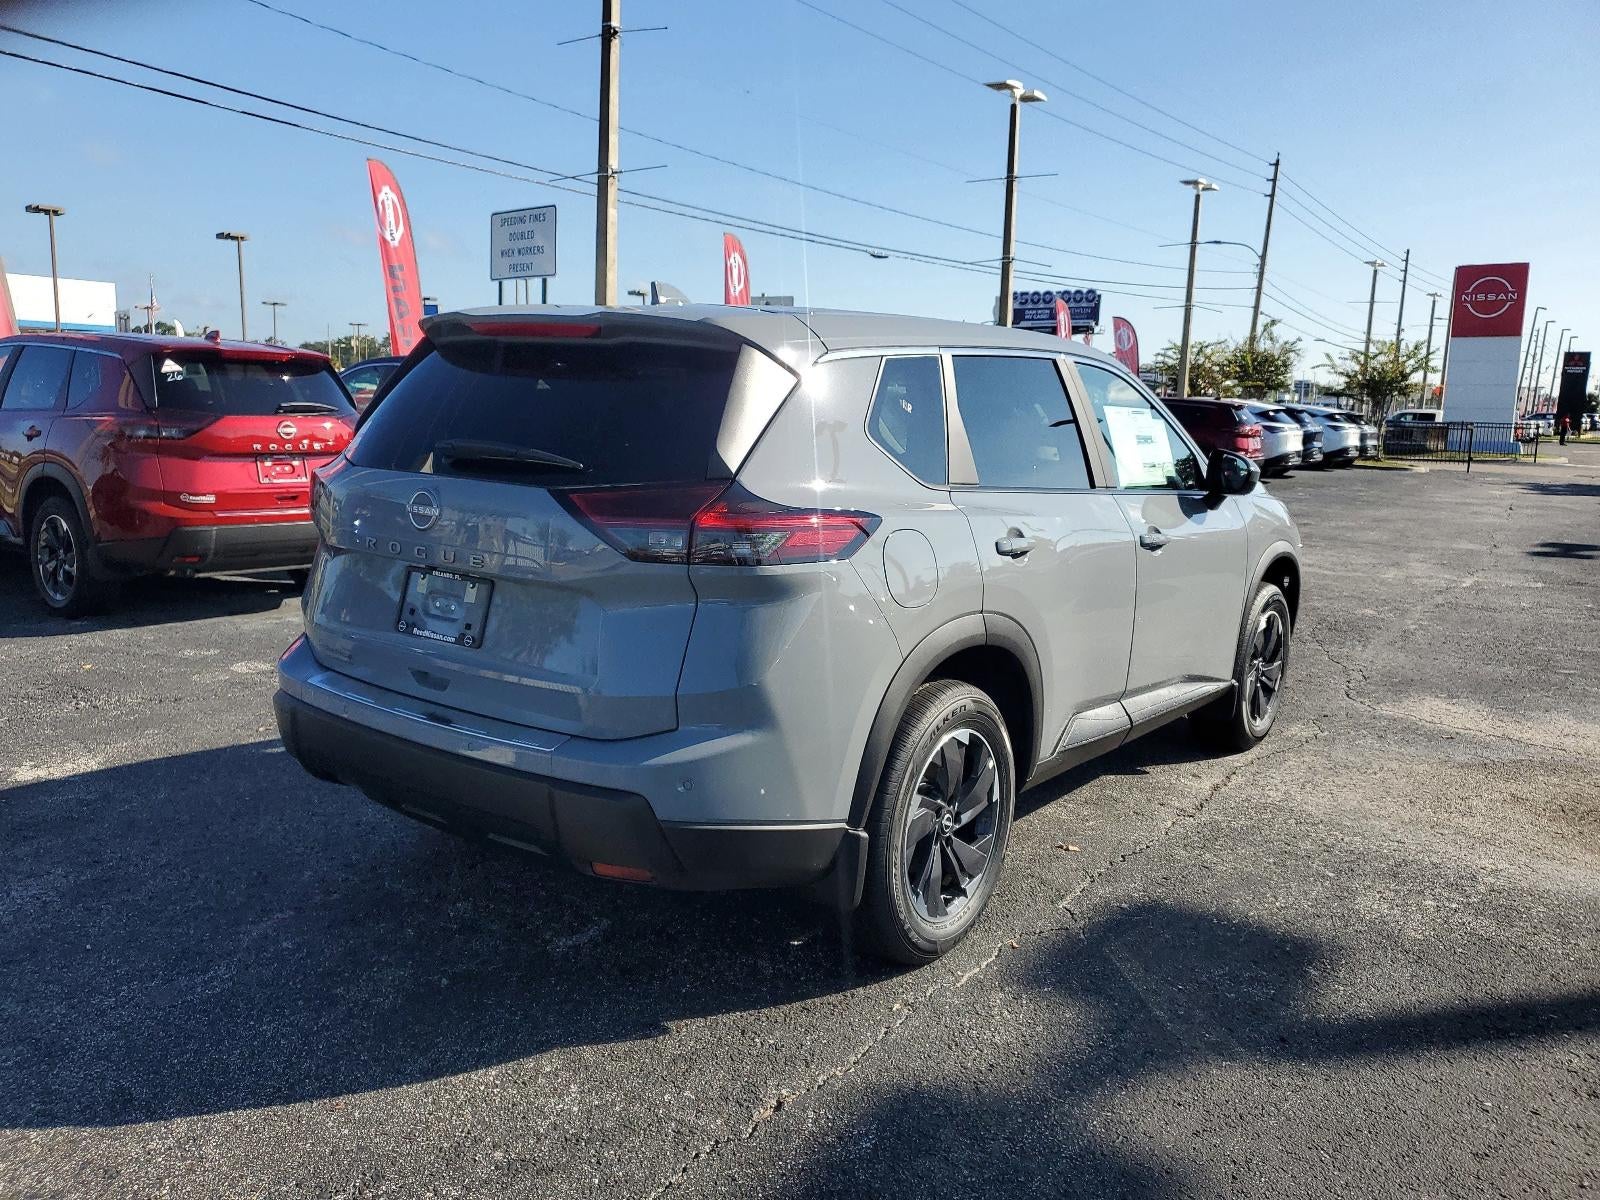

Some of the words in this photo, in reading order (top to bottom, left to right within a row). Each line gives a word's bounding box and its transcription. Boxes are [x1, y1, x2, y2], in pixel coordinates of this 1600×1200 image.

[500, 215, 527, 227] SPEEDING
[529, 212, 546, 223] FINES
[509, 230, 535, 241] DOUBLED
[501, 248, 516, 258] WHEN
[518, 245, 545, 256] WORKERS
[508, 262, 533, 272] PRESENT
[1462, 292, 1518, 302] NISSAN
[167, 371, 184, 382] 26
[253, 443, 324, 451] ROGUE
[407, 504, 439, 516] NISSAN
[367, 537, 485, 567] ROGUE
[412, 627, 456, 643] ReedNissan.com
